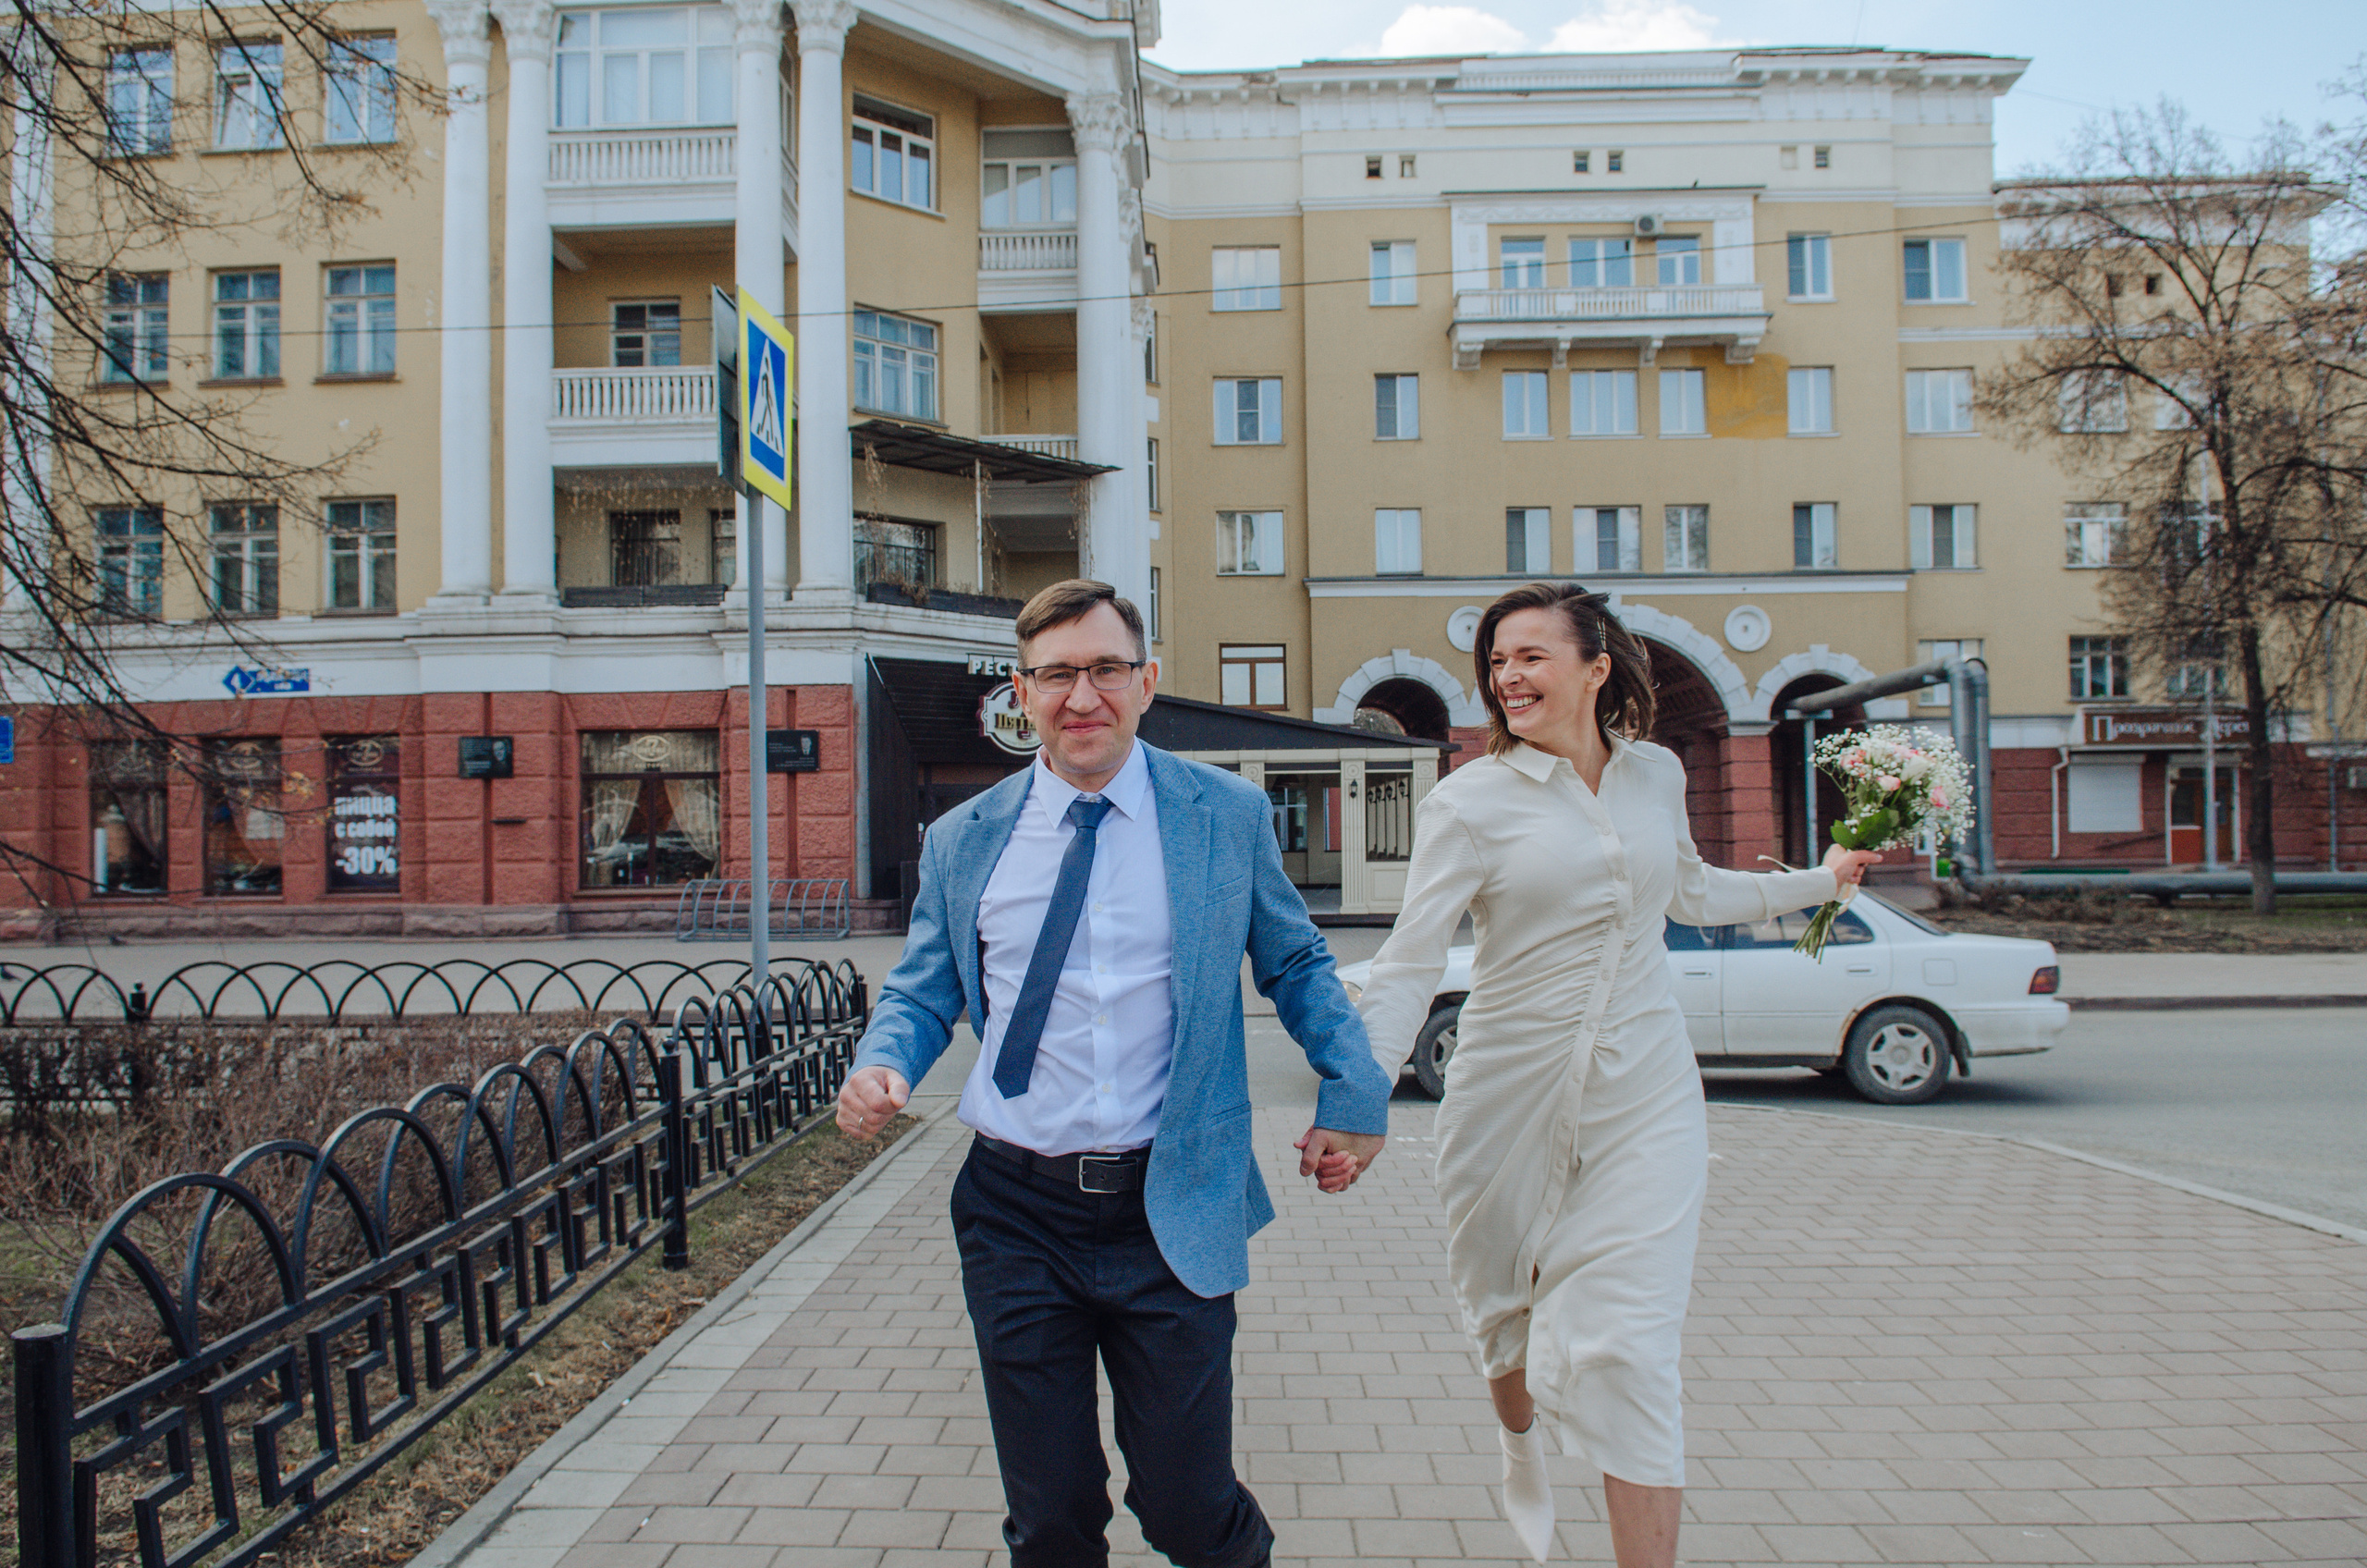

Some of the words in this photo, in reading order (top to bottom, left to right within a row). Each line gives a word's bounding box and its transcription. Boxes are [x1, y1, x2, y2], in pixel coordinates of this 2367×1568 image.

[335, 822, 346, 838] с
[347, 818, 397, 838] собой
[335, 846, 397, 875] -30%
